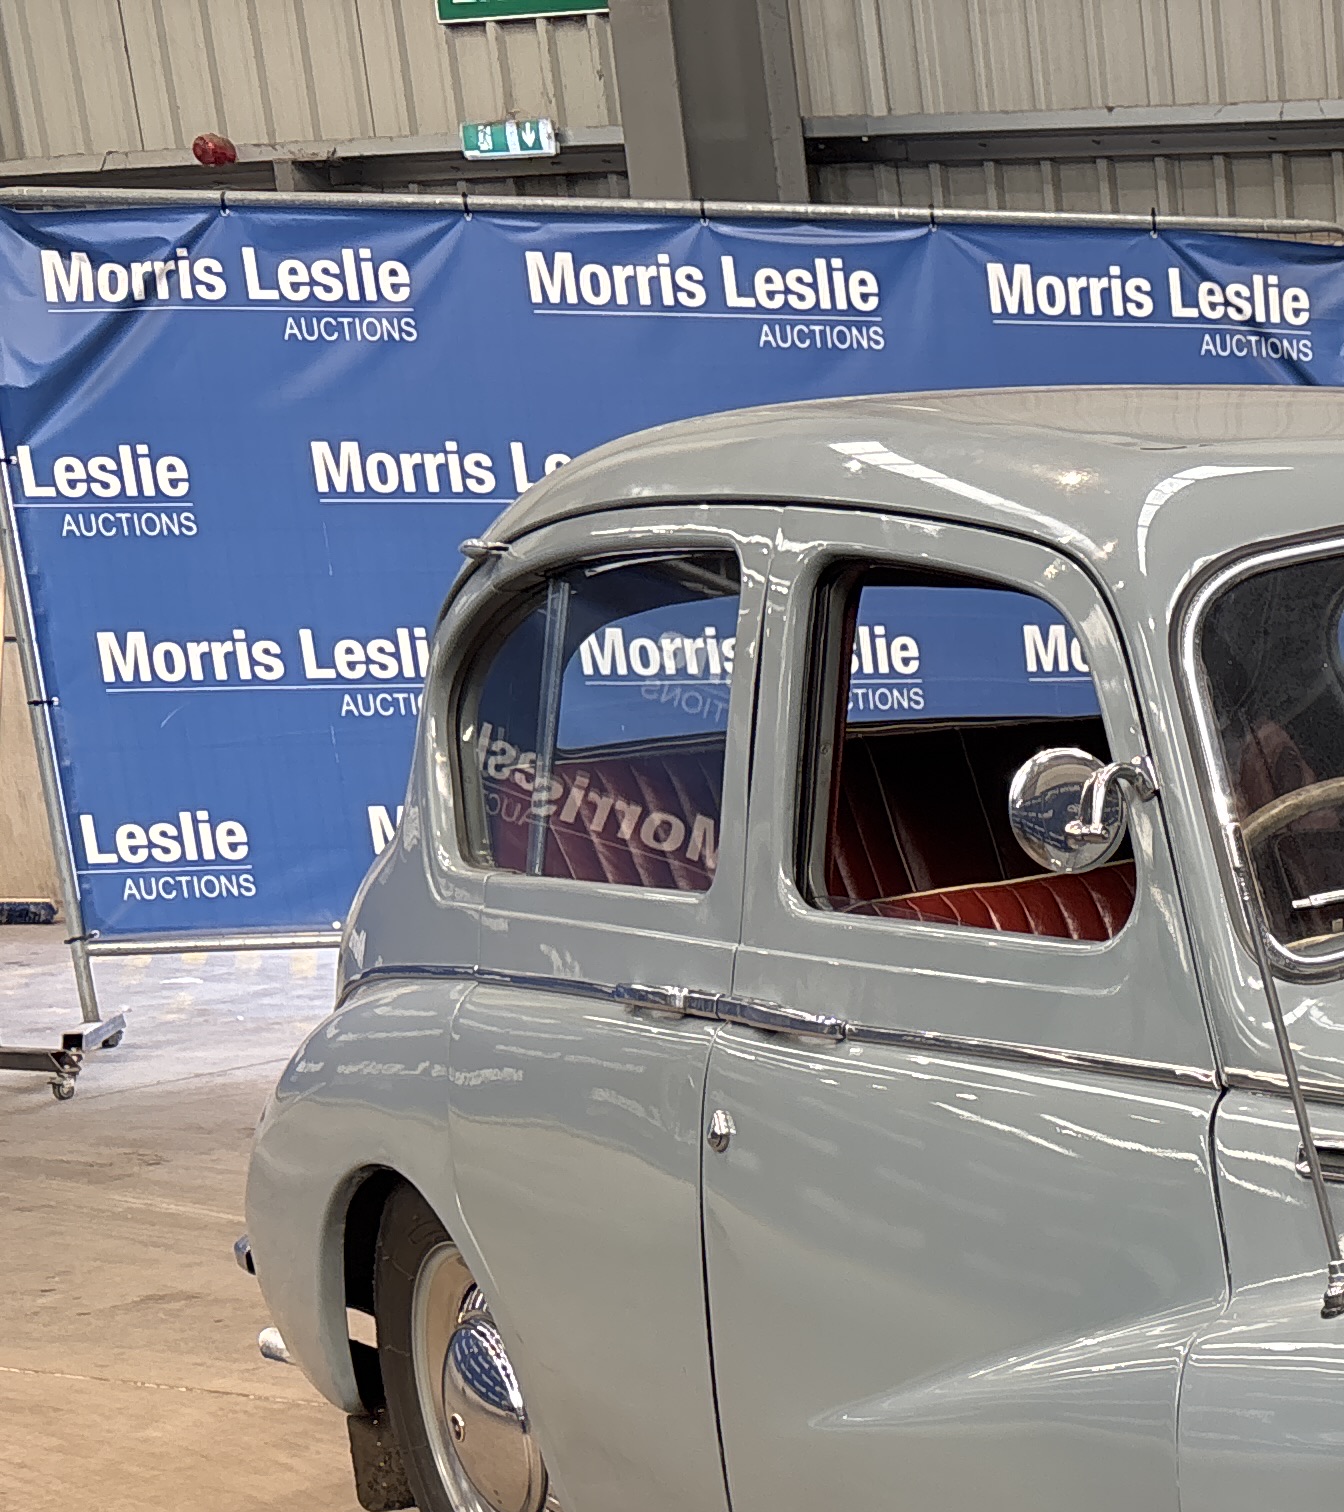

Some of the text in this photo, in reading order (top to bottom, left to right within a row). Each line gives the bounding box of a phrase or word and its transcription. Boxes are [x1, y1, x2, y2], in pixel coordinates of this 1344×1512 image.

[41, 247, 410, 302] Morris Leslie
[525, 251, 878, 311] Morris Leslie
[987, 263, 1309, 325] Morris Leslie
[285, 317, 417, 341] AUCTIONS
[760, 324, 884, 349] AUCTIONS
[1201, 334, 1312, 361] AUCTIONS
[16, 445, 189, 497] Leslie
[311, 441, 495, 493] Morris
[63, 512, 197, 536] AUCTIONS
[97, 628, 429, 682] Morris Lesli
[851, 626, 919, 674] lie
[340, 694, 422, 717] AUCTI
[848, 688, 924, 710] TIONS
[80, 811, 248, 863] Leslie
[124, 874, 256, 900] AUCTIONS
